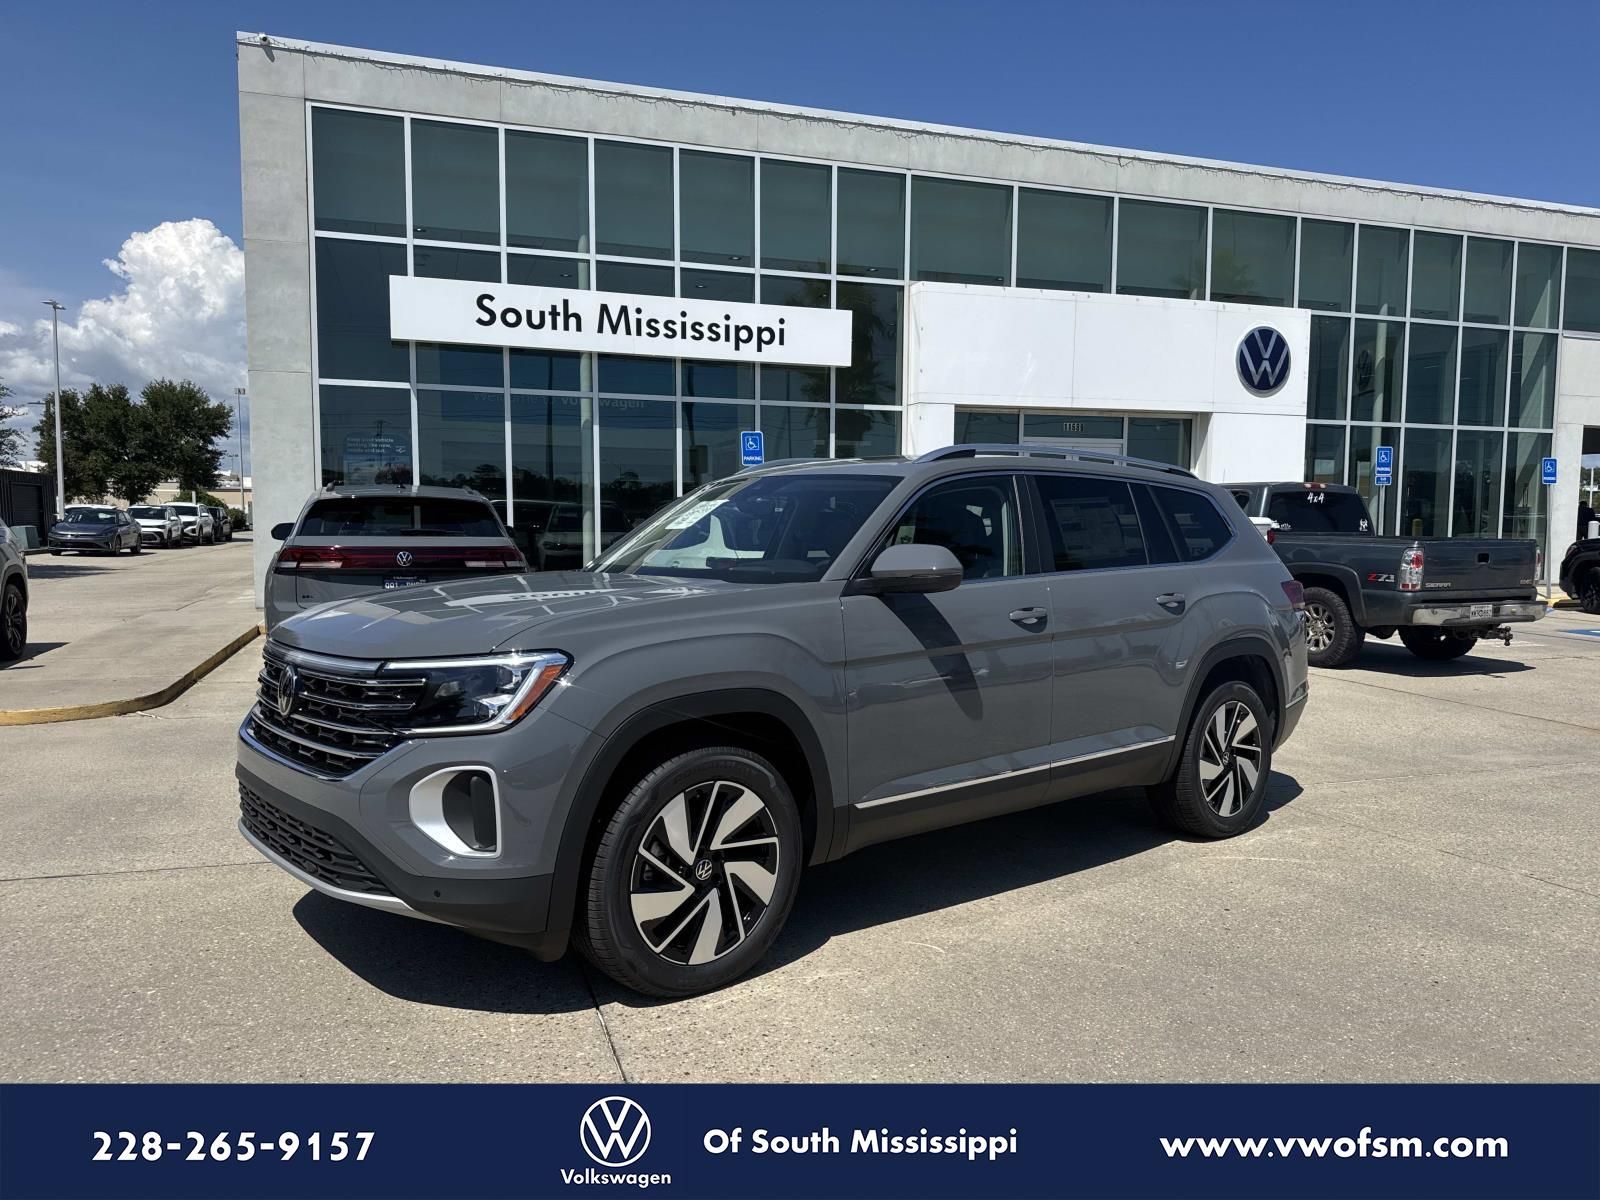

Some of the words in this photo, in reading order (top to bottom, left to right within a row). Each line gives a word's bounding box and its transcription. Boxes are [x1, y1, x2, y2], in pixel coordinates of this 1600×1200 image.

[474, 293, 582, 333] South
[596, 303, 786, 353] Mississippi
[1307, 492, 1325, 504] 4x4
[1367, 572, 1395, 582] Z71
